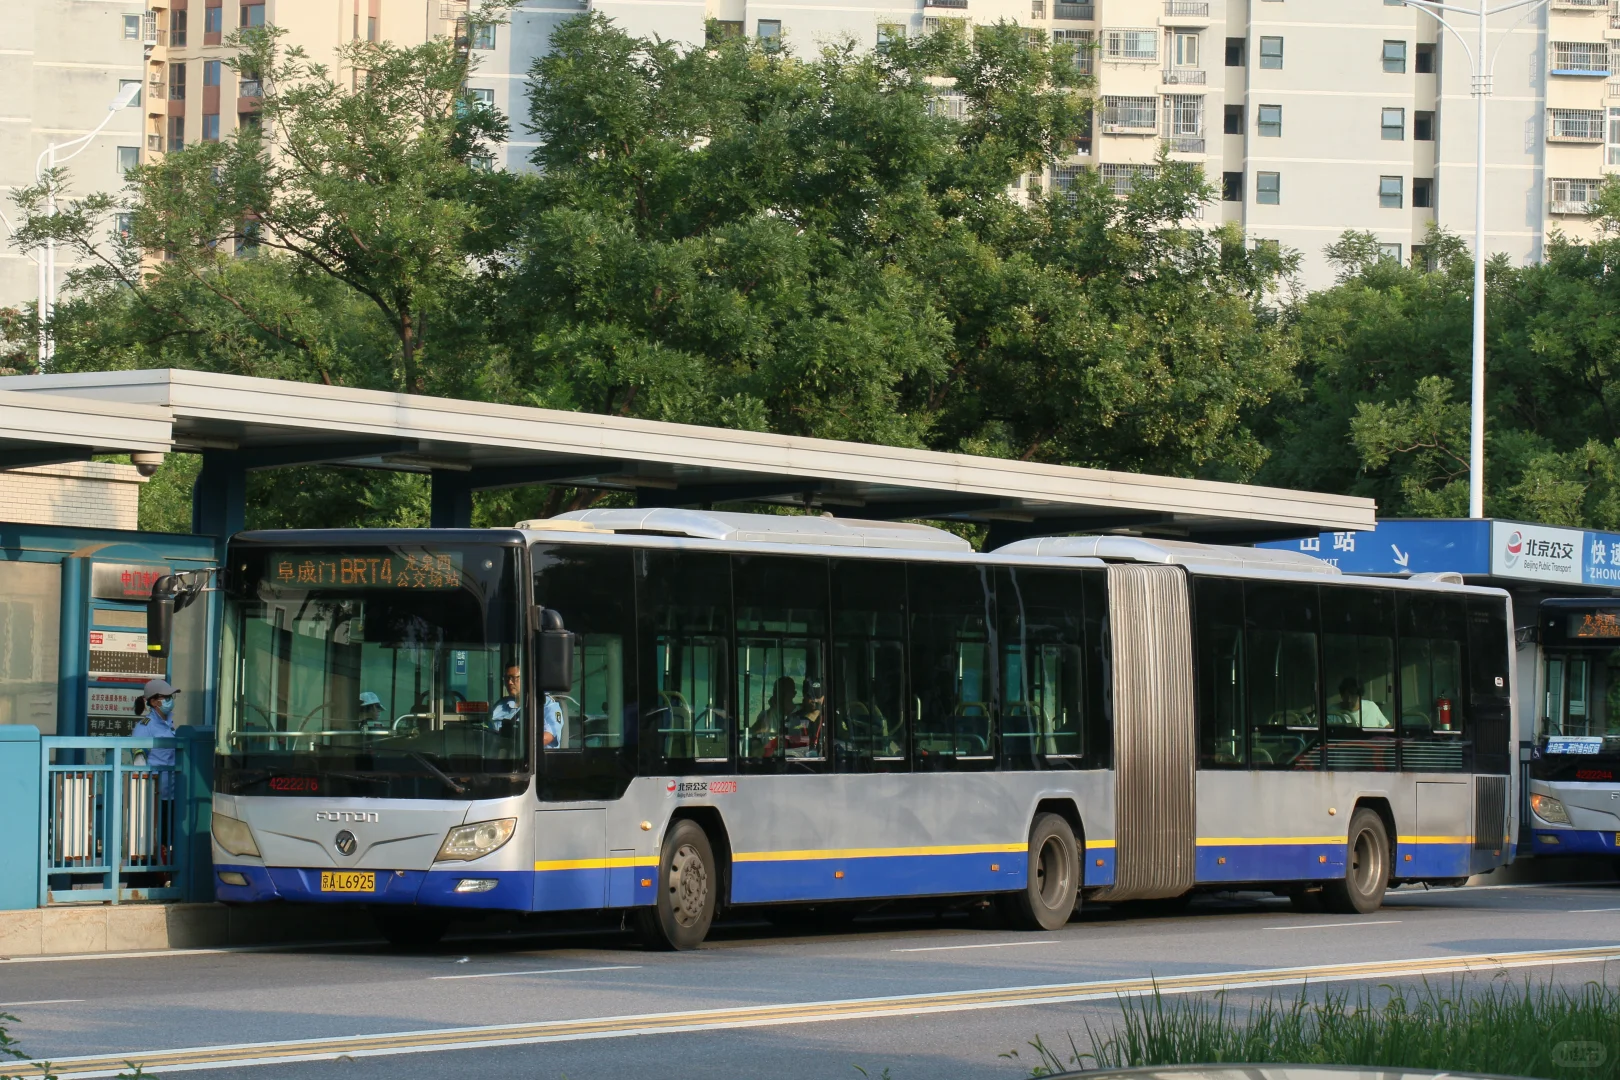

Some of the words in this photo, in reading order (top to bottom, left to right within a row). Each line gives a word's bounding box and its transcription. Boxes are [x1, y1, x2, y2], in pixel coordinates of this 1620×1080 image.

[1525, 539, 1574, 559] 北京公交
[405, 554, 452, 571] 龙泉西
[1319, 558, 1339, 567] XIT
[1524, 560, 1538, 572] Beijing
[1539, 561, 1551, 571] Public
[1551, 562, 1572, 574] Transport
[277, 560, 336, 584] 阜成门
[341, 558, 392, 584] BRT4
[395, 570, 460, 588] 公交场站
[90, 719, 122, 730] 有序上车
[268, 777, 318, 791] 4222276
[677, 782, 708, 792] 北京公交
[709, 781, 737, 793] 4222276
[316, 811, 379, 823] FOTON
